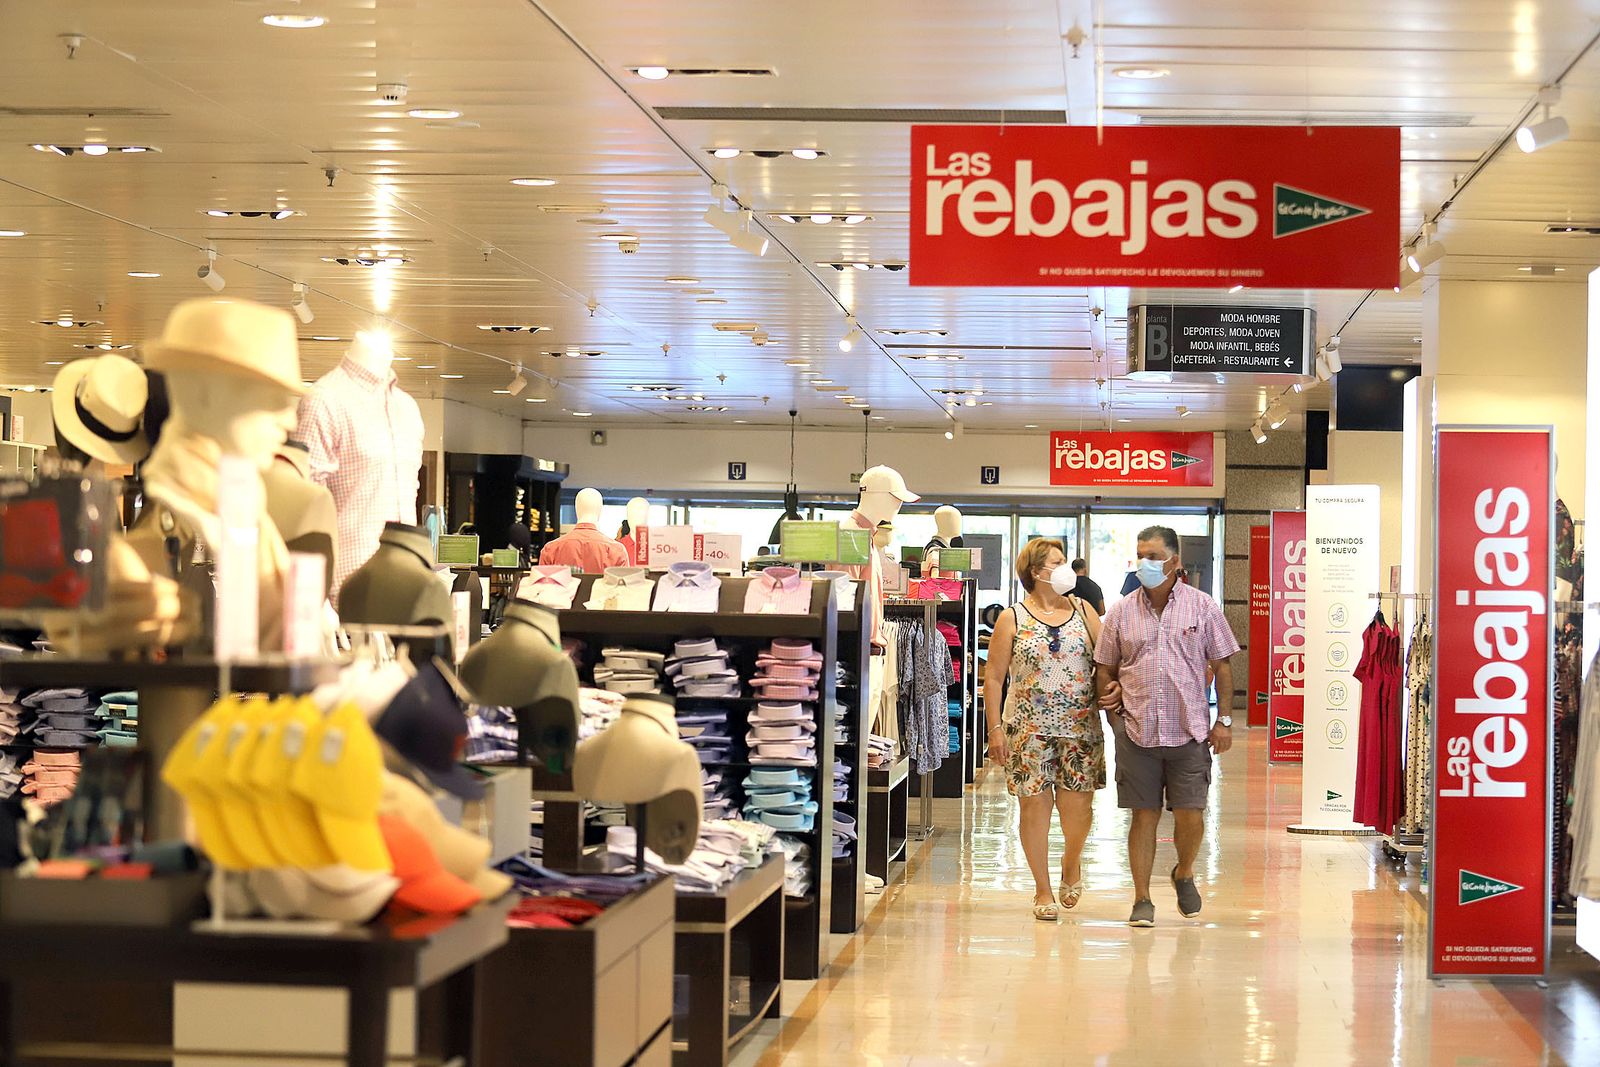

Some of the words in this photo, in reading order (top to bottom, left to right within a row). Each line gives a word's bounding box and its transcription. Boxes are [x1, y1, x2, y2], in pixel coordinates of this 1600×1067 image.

[926, 145, 991, 177] Las
[925, 160, 1259, 256] rebajas
[1050, 267, 1063, 276] NO
[1064, 267, 1093, 277] QUEDA
[1094, 268, 1147, 277] SATISFECHO
[1147, 268, 1159, 277] LE
[1217, 269, 1230, 277] SU
[1230, 269, 1264, 278] DINERO
[1146, 314, 1167, 324] planta
[1220, 313, 1245, 322] MODA
[1246, 314, 1281, 324] HOMBRE
[1183, 327, 1227, 337] DEPORTES,
[1229, 328, 1253, 337] MODA
[1255, 329, 1281, 338] JOVEN
[1147, 325, 1168, 361] B
[1190, 341, 1215, 350] MODA
[1216, 342, 1253, 352] INFANTIL,
[1255, 341, 1280, 352] BEBÉS
[1173, 354, 1216, 364] CAFETERÍA
[1224, 356, 1280, 366] RESTAURANTE
[1055, 437, 1078, 449] Las
[1055, 443, 1167, 476] rebajas
[652, 544, 678, 554] -50%
[705, 550, 730, 559] -40%
[1274, 540, 1306, 696] rebajas
[1455, 486, 1547, 798] rebajas
[1272, 668, 1283, 696] Las
[1439, 736, 1471, 798] Las
